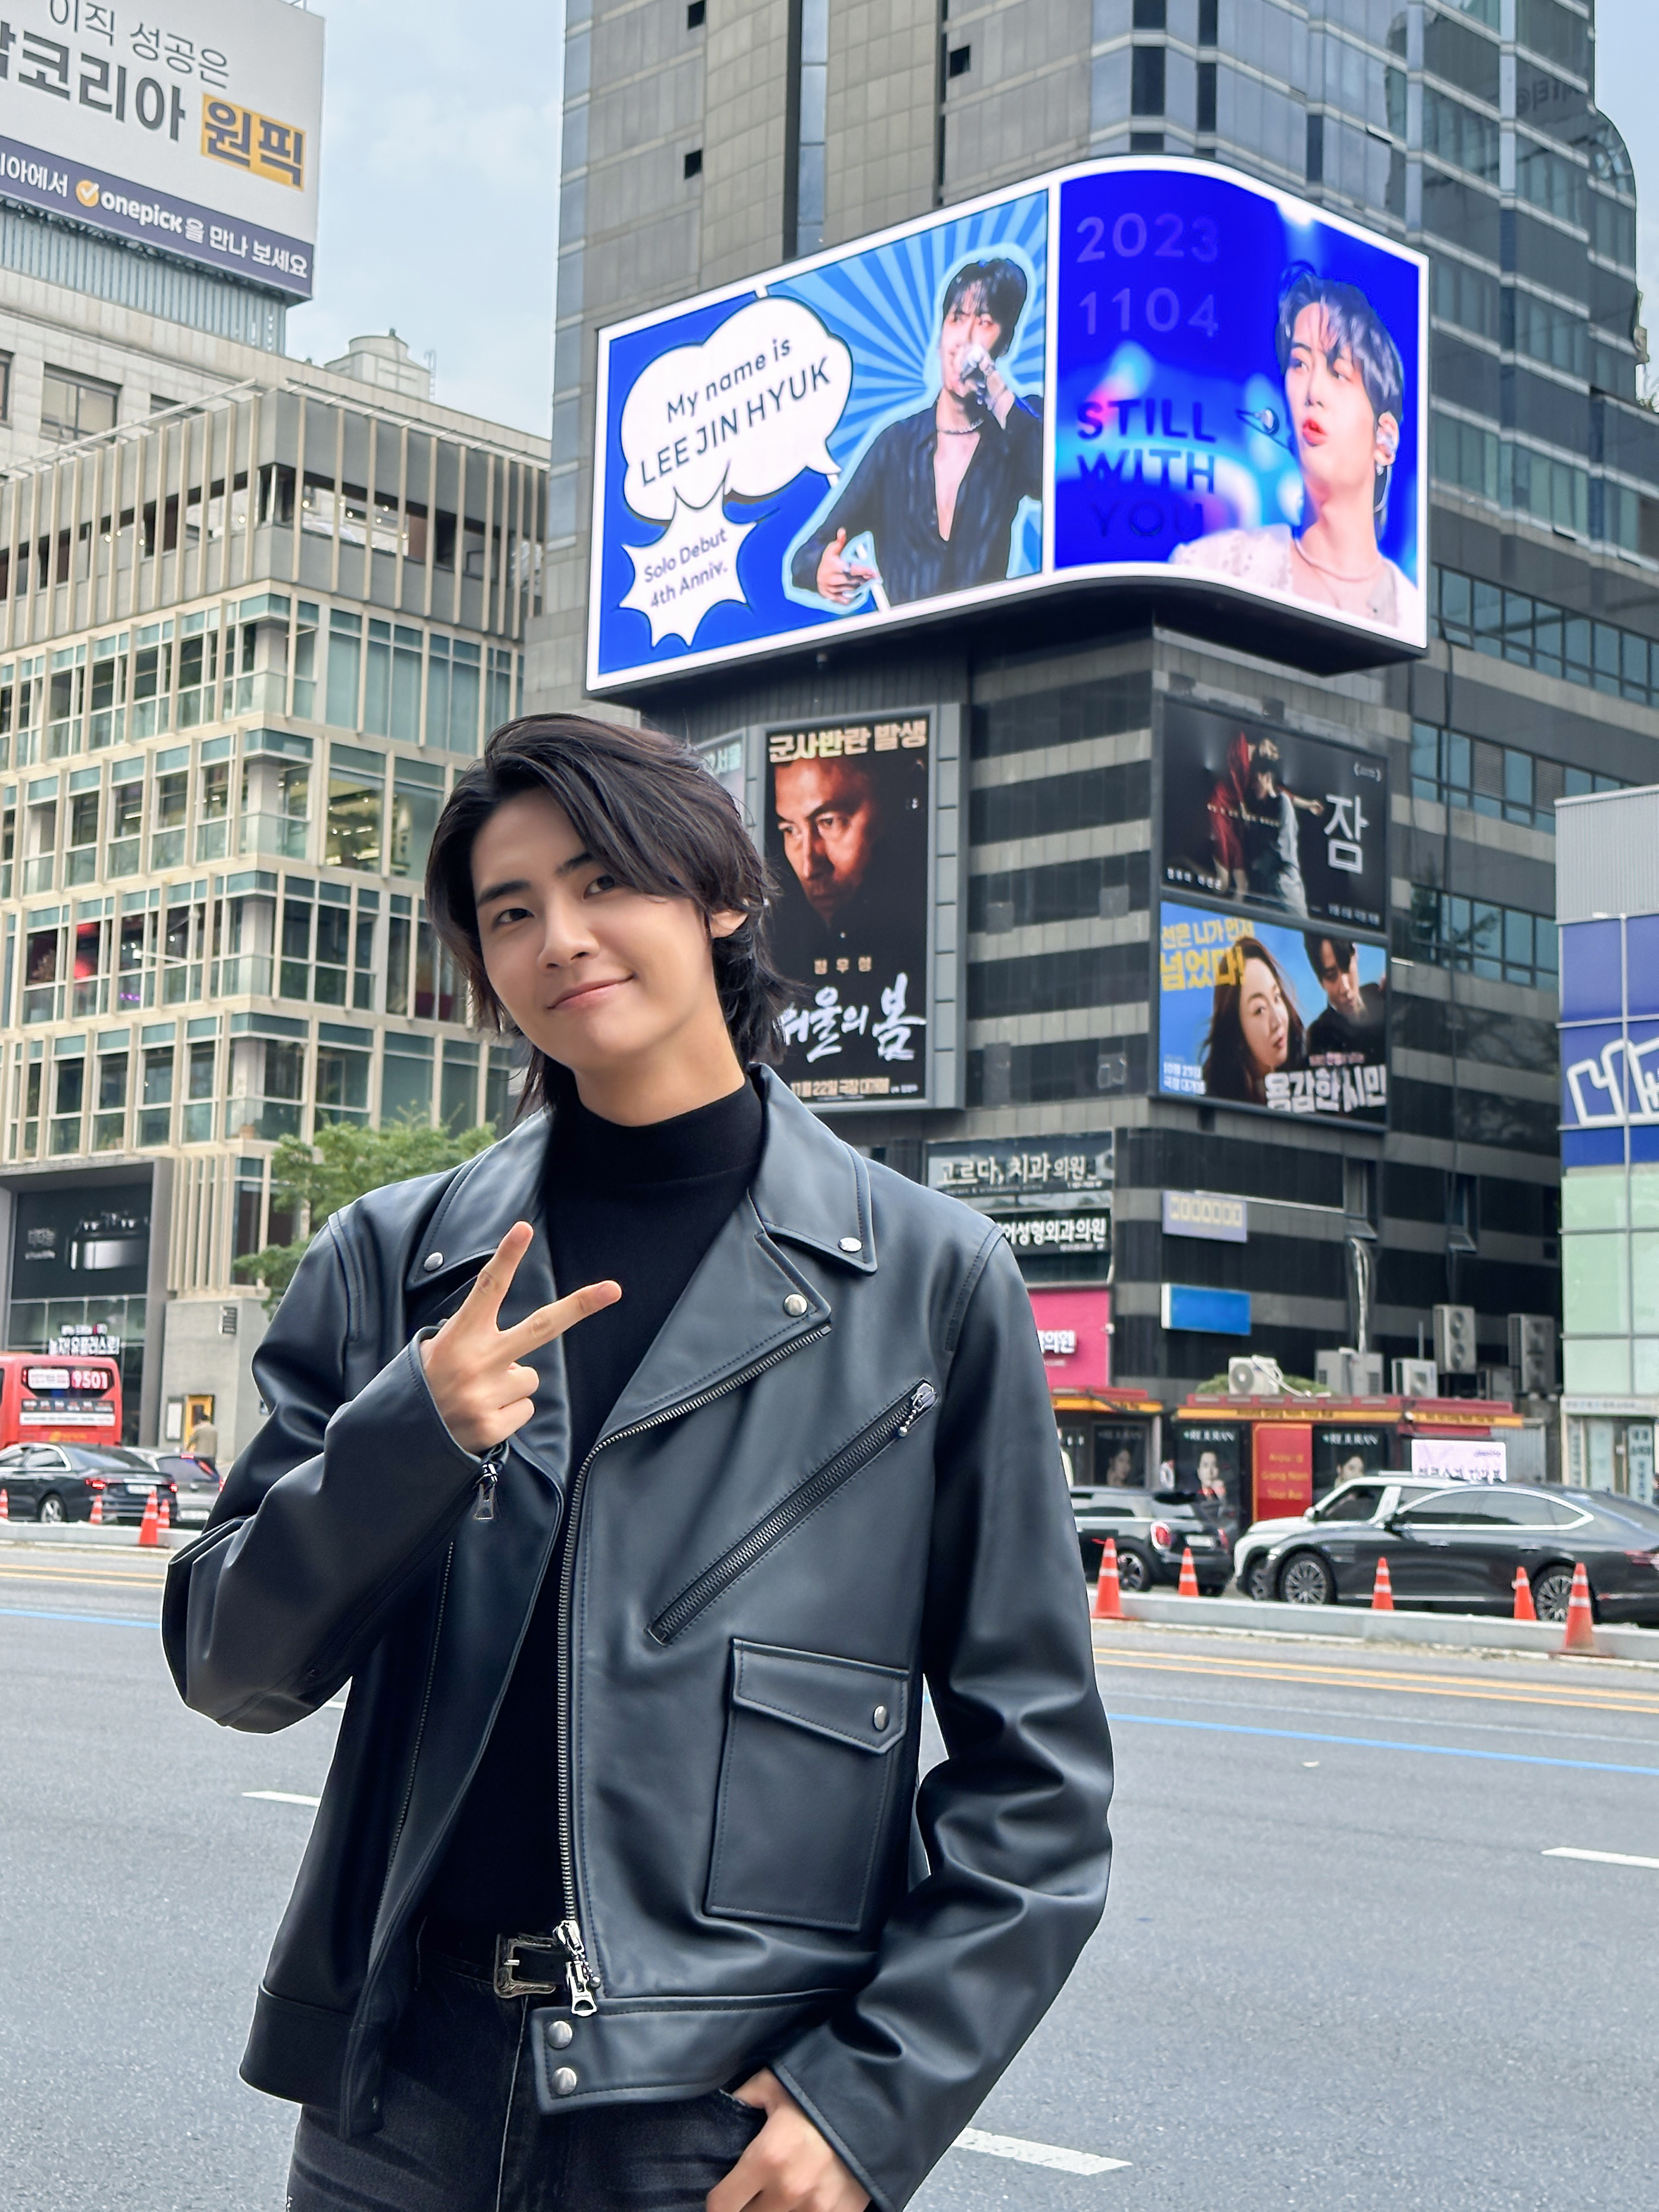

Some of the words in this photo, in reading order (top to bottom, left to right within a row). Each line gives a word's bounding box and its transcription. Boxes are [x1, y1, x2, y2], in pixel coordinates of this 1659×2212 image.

[50, 0, 114, 47] 이직
[131, 22, 230, 90] 성공은
[204, 101, 303, 187] 원픽
[210, 225, 249, 258] 만나
[252, 239, 308, 279] 보세요
[1077, 213, 1219, 263] 2023
[1078, 287, 1219, 337] 1104
[668, 392, 698, 423] My
[706, 354, 765, 401] name
[773, 338, 790, 362] is
[641, 436, 690, 487] LEE
[696, 408, 738, 456] JIN
[747, 357, 830, 427] HYUK
[1077, 398, 1217, 444] STILL
[1077, 449, 1215, 494] WITH
[644, 557, 677, 583] Solo
[679, 528, 727, 565] Debut
[650, 584, 676, 607] 4th
[680, 561, 728, 596] Anniv.
[769, 726, 872, 763] 군사반란
[874, 718, 927, 752] 발생
[1323, 793, 1370, 875] 잠
[872, 971, 927, 1061] 봄
[1037, 1329, 1077, 1354] 의원
[72, 1370, 108, 1390] 9501
